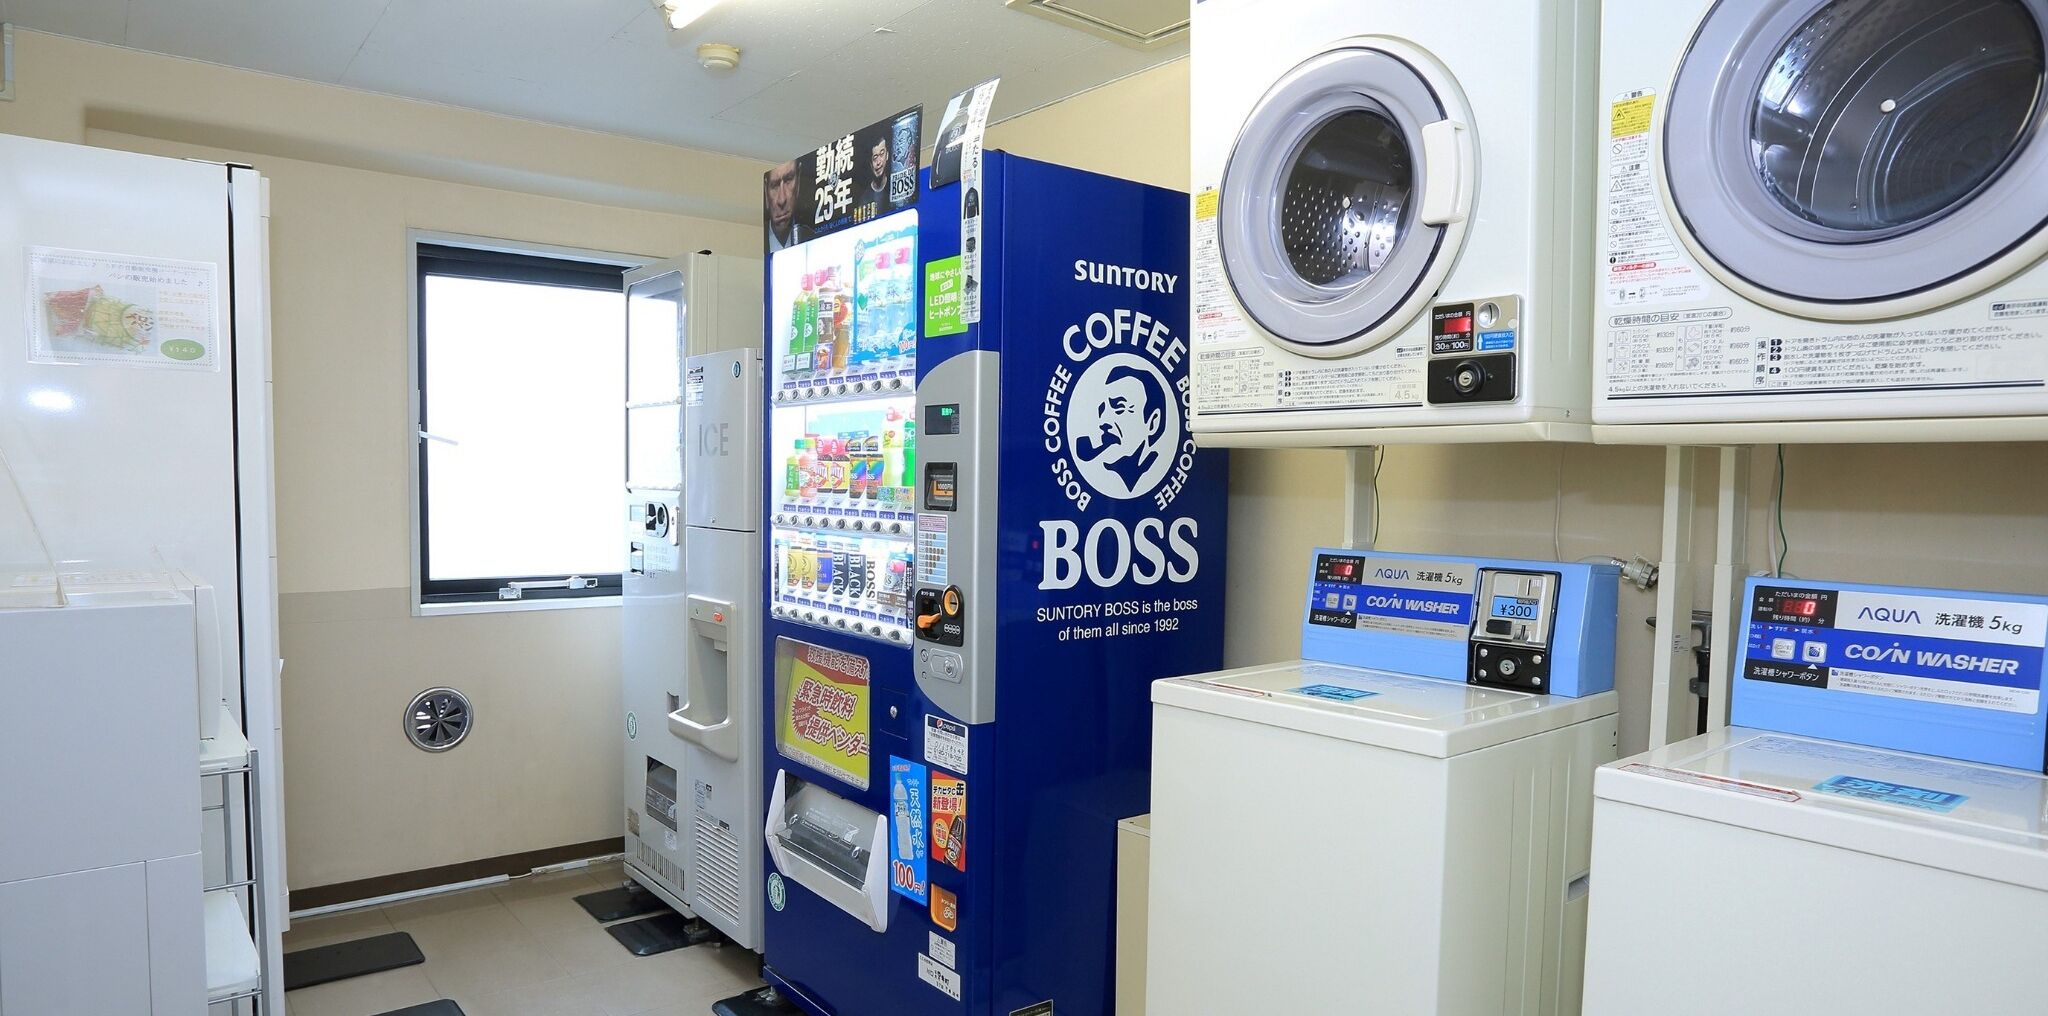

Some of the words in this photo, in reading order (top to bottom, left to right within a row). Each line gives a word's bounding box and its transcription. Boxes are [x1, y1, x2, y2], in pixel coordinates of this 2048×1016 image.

[815, 133, 855, 185] 勤続
[814, 178, 853, 225] 25年
[1074, 259, 1178, 294] SUNTORY
[1613, 313, 1680, 326] 乾燥時間の目安
[1063, 309, 1188, 374] COFFEE
[1043, 363, 1073, 453] COFFEE
[698, 423, 729, 457] ICE
[1051, 457, 1092, 512] BOSS
[1154, 438, 1197, 511] COFFEE
[1038, 517, 1199, 590] BOSS
[832, 551, 844, 596] BLACK
[848, 553, 861, 599] BLACK
[866, 560, 876, 600] BOSS
[1375, 568, 1410, 581] AQUA
[1416, 571, 1443, 583] 洗濯機
[1444, 572, 1463, 586] 5kg
[1036, 603, 1102, 622] SUNTORY
[1104, 600, 1139, 617] BOSS
[1142, 600, 1151, 614] is
[1154, 599, 1171, 613] the
[1173, 598, 1198, 611] boss
[1366, 593, 1402, 607] COIN
[1405, 600, 1460, 615] WASHER
[1500, 604, 1532, 618] ¥300
[1775, 591, 1818, 600] ただいまの金額
[1803, 601, 1816, 615] 0
[1058, 626, 1070, 641] of
[1073, 625, 1102, 640] them
[1105, 622, 1119, 637] all
[1121, 621, 1150, 635] since
[1154, 617, 1180, 632] 1992
[1857, 606, 1921, 625] AQUA
[1934, 612, 1985, 629] 洗濯機
[1988, 615, 2023, 635] 5kg
[1753, 666, 1820, 682] 洗濯槽シャワーボタン
[1844, 642, 1911, 664] COIN
[1916, 650, 2020, 676] WASHER
[797, 676, 858, 721] 緊急時飲料
[804, 714, 870, 757] 提供ベンダー
